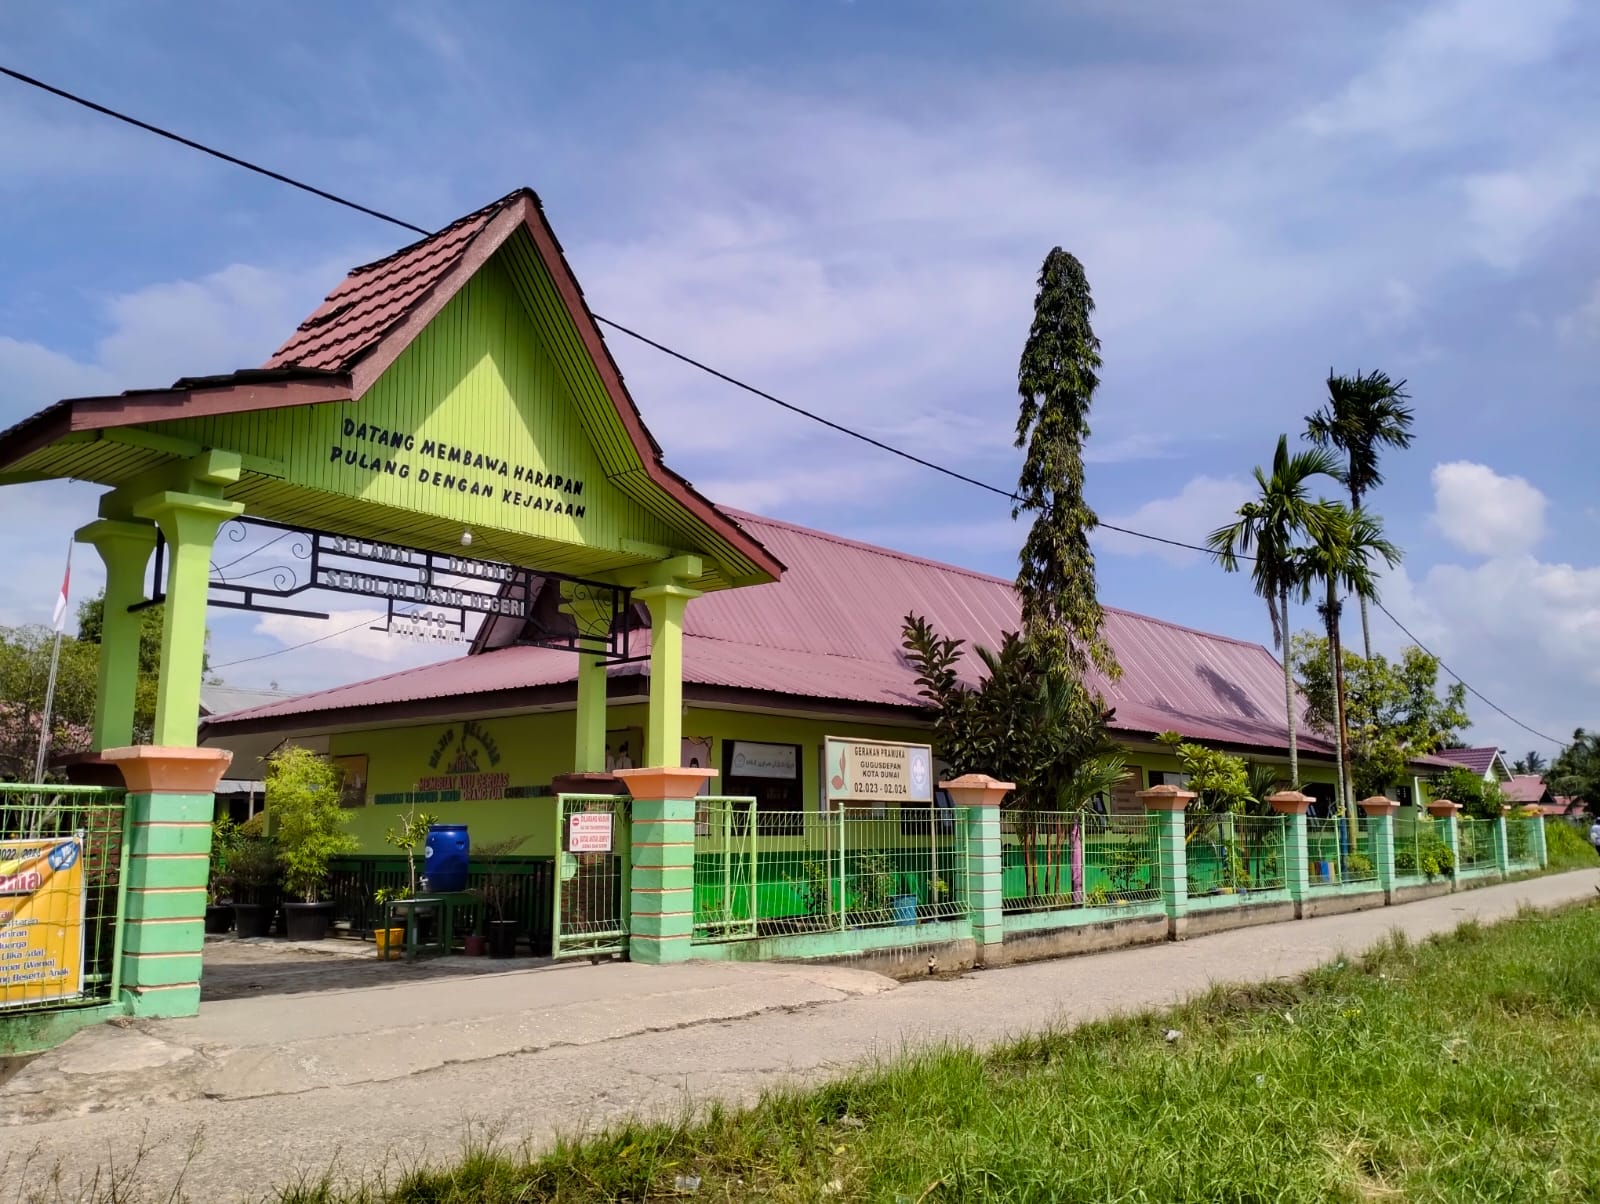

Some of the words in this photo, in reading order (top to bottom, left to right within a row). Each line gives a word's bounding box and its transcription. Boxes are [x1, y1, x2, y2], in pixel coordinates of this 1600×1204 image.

[343, 418, 415, 451] DATANG
[420, 439, 508, 476] MEMBAWA
[513, 465, 584, 496] HARAPAN
[330, 446, 410, 478] PULANG
[418, 468, 493, 498] DENGAN
[502, 488, 586, 518] KEJAYAAN
[333, 537, 415, 564] SELAMAT
[448, 556, 513, 582] DATANG
[419, 567, 435, 585] DI
[326, 570, 407, 598] SEKOLAH
[414, 587, 463, 606] DASAR
[470, 594, 525, 617] NEGERI
[411, 609, 446, 628] 018
[388, 622, 467, 645] PURNAMA
[854, 746, 880, 757] GERAKAN
[881, 748, 905, 758] PRAMUKA
[860, 760, 901, 770] GUGUSDEPAN
[863, 770, 879, 778] KOTA
[880, 771, 900, 779] DUMAI
[854, 782, 879, 793] 02.023
[884, 783, 907, 794] 02.024
